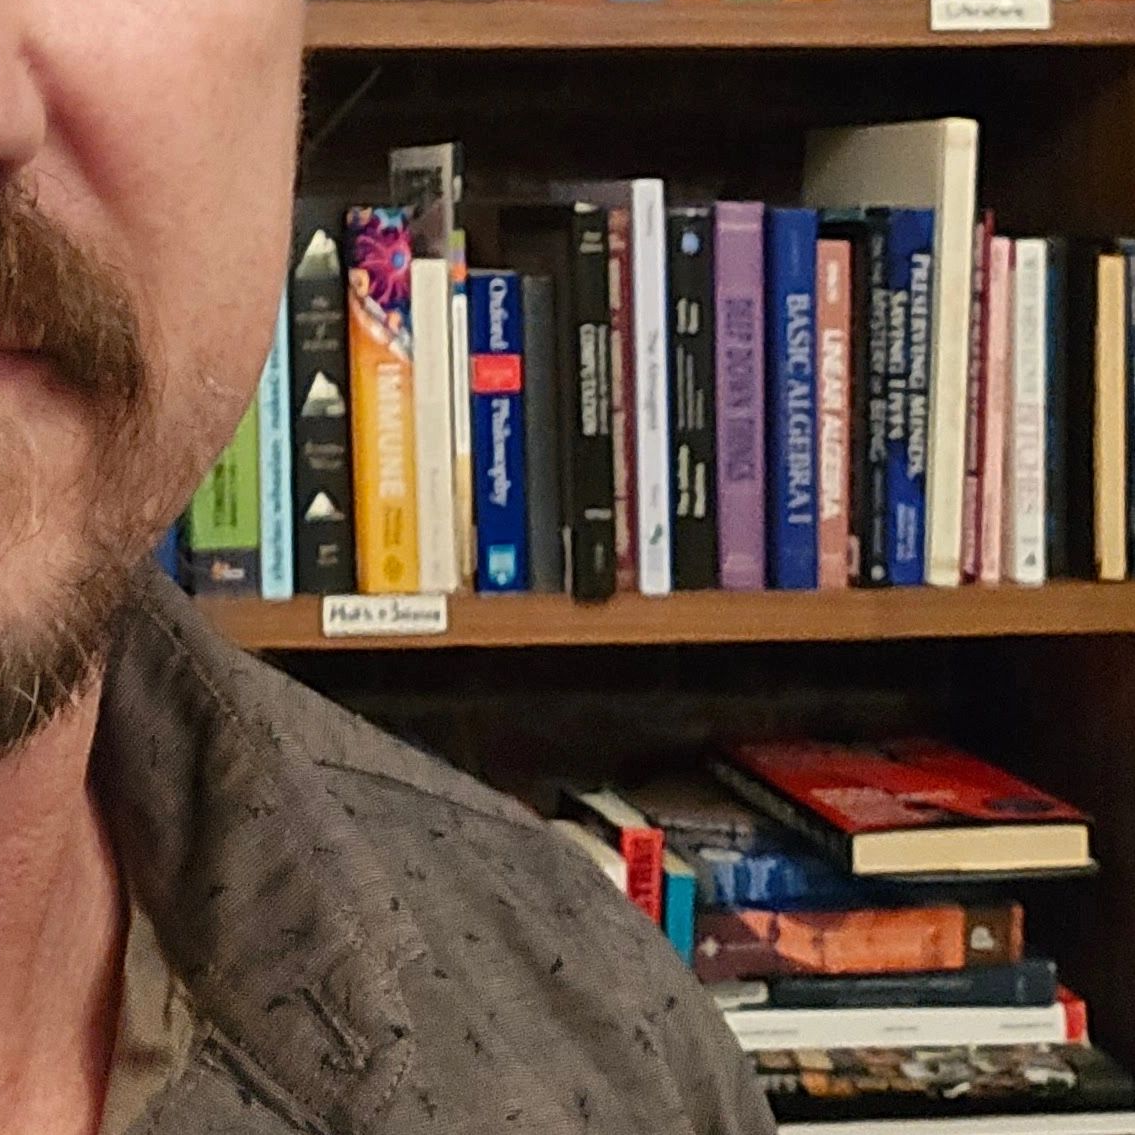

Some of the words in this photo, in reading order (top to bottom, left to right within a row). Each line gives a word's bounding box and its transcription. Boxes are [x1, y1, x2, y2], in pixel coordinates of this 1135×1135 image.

[488, 277, 509, 351] Oxford
[785, 293, 812, 375] BASIC
[822, 328, 845, 410] LINEAR
[377, 363, 406, 499] IMMUNE
[787, 379, 812, 509] ALGEBRA
[820, 412, 843, 523] ALGEBRA
[788, 512, 812, 524] I
